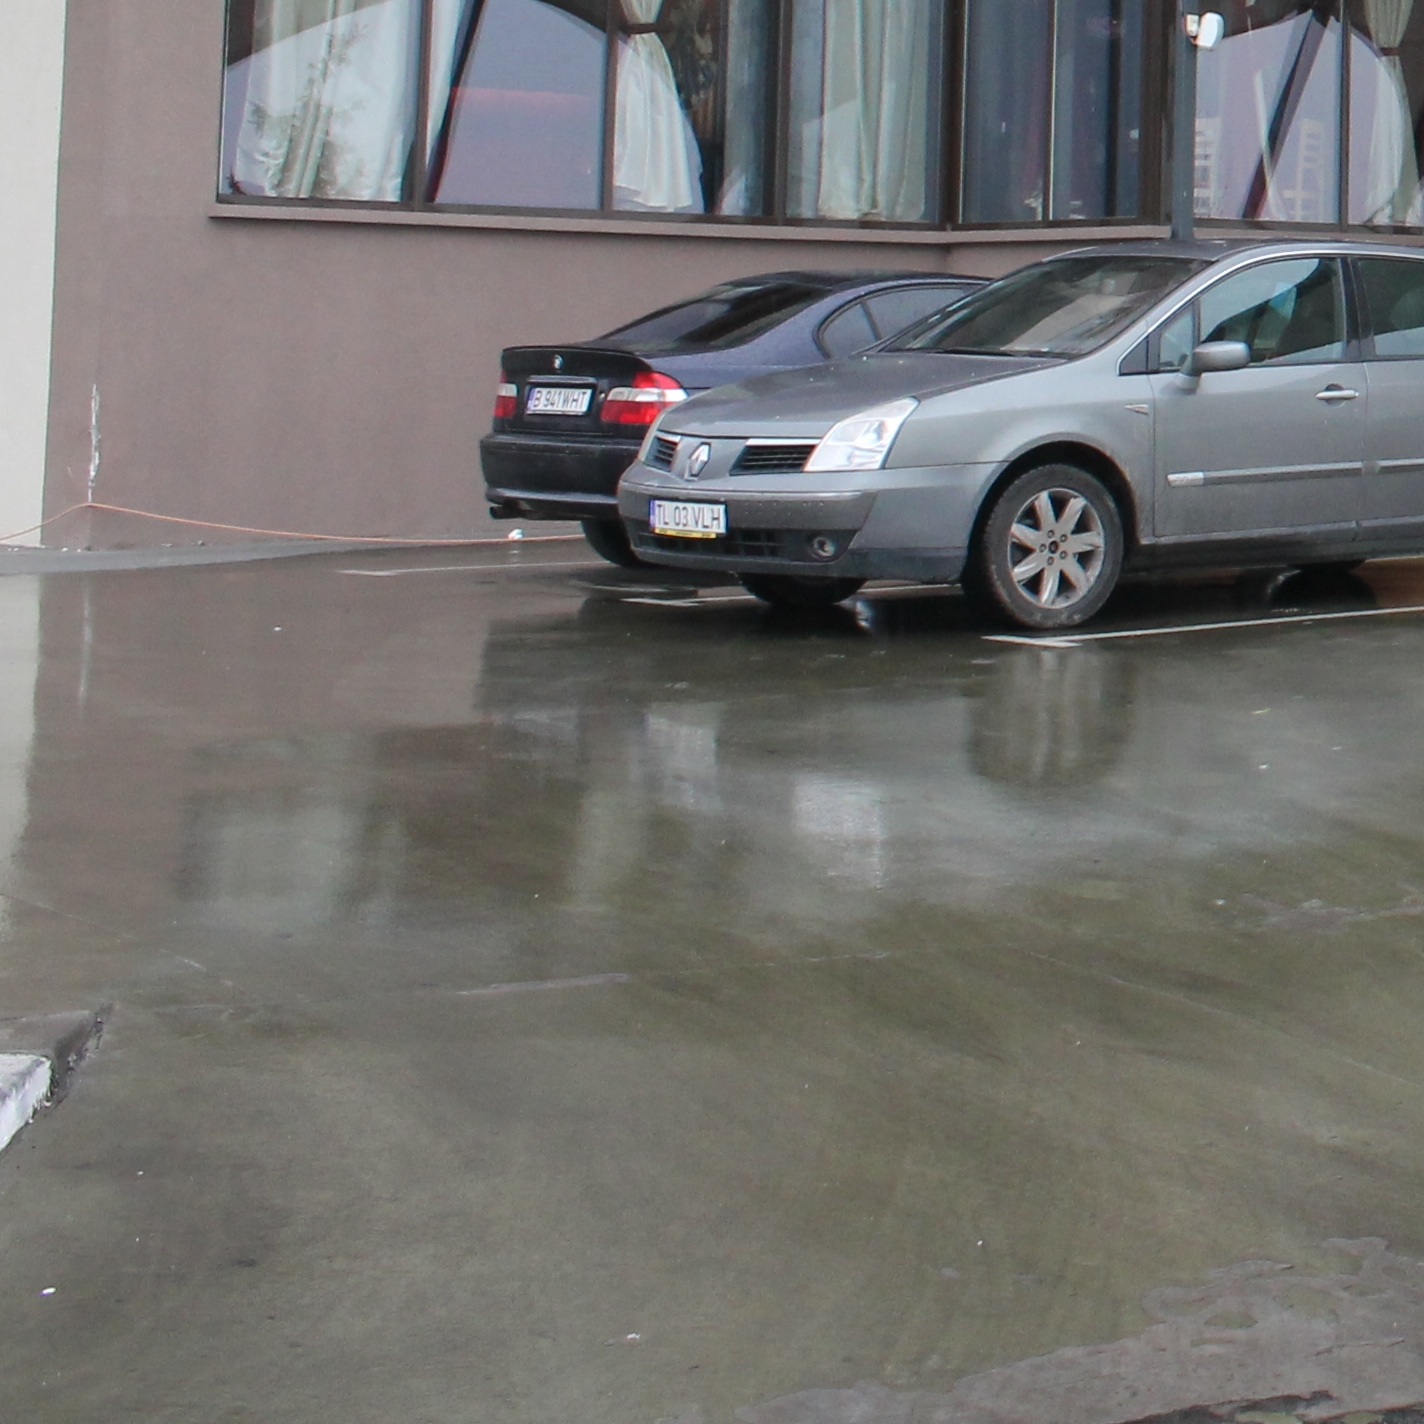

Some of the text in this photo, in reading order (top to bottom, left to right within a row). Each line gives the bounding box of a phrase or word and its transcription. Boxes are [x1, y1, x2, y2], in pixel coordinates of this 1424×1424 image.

[533, 390, 543, 407] B
[656, 504, 721, 529] TL 03 VLH
